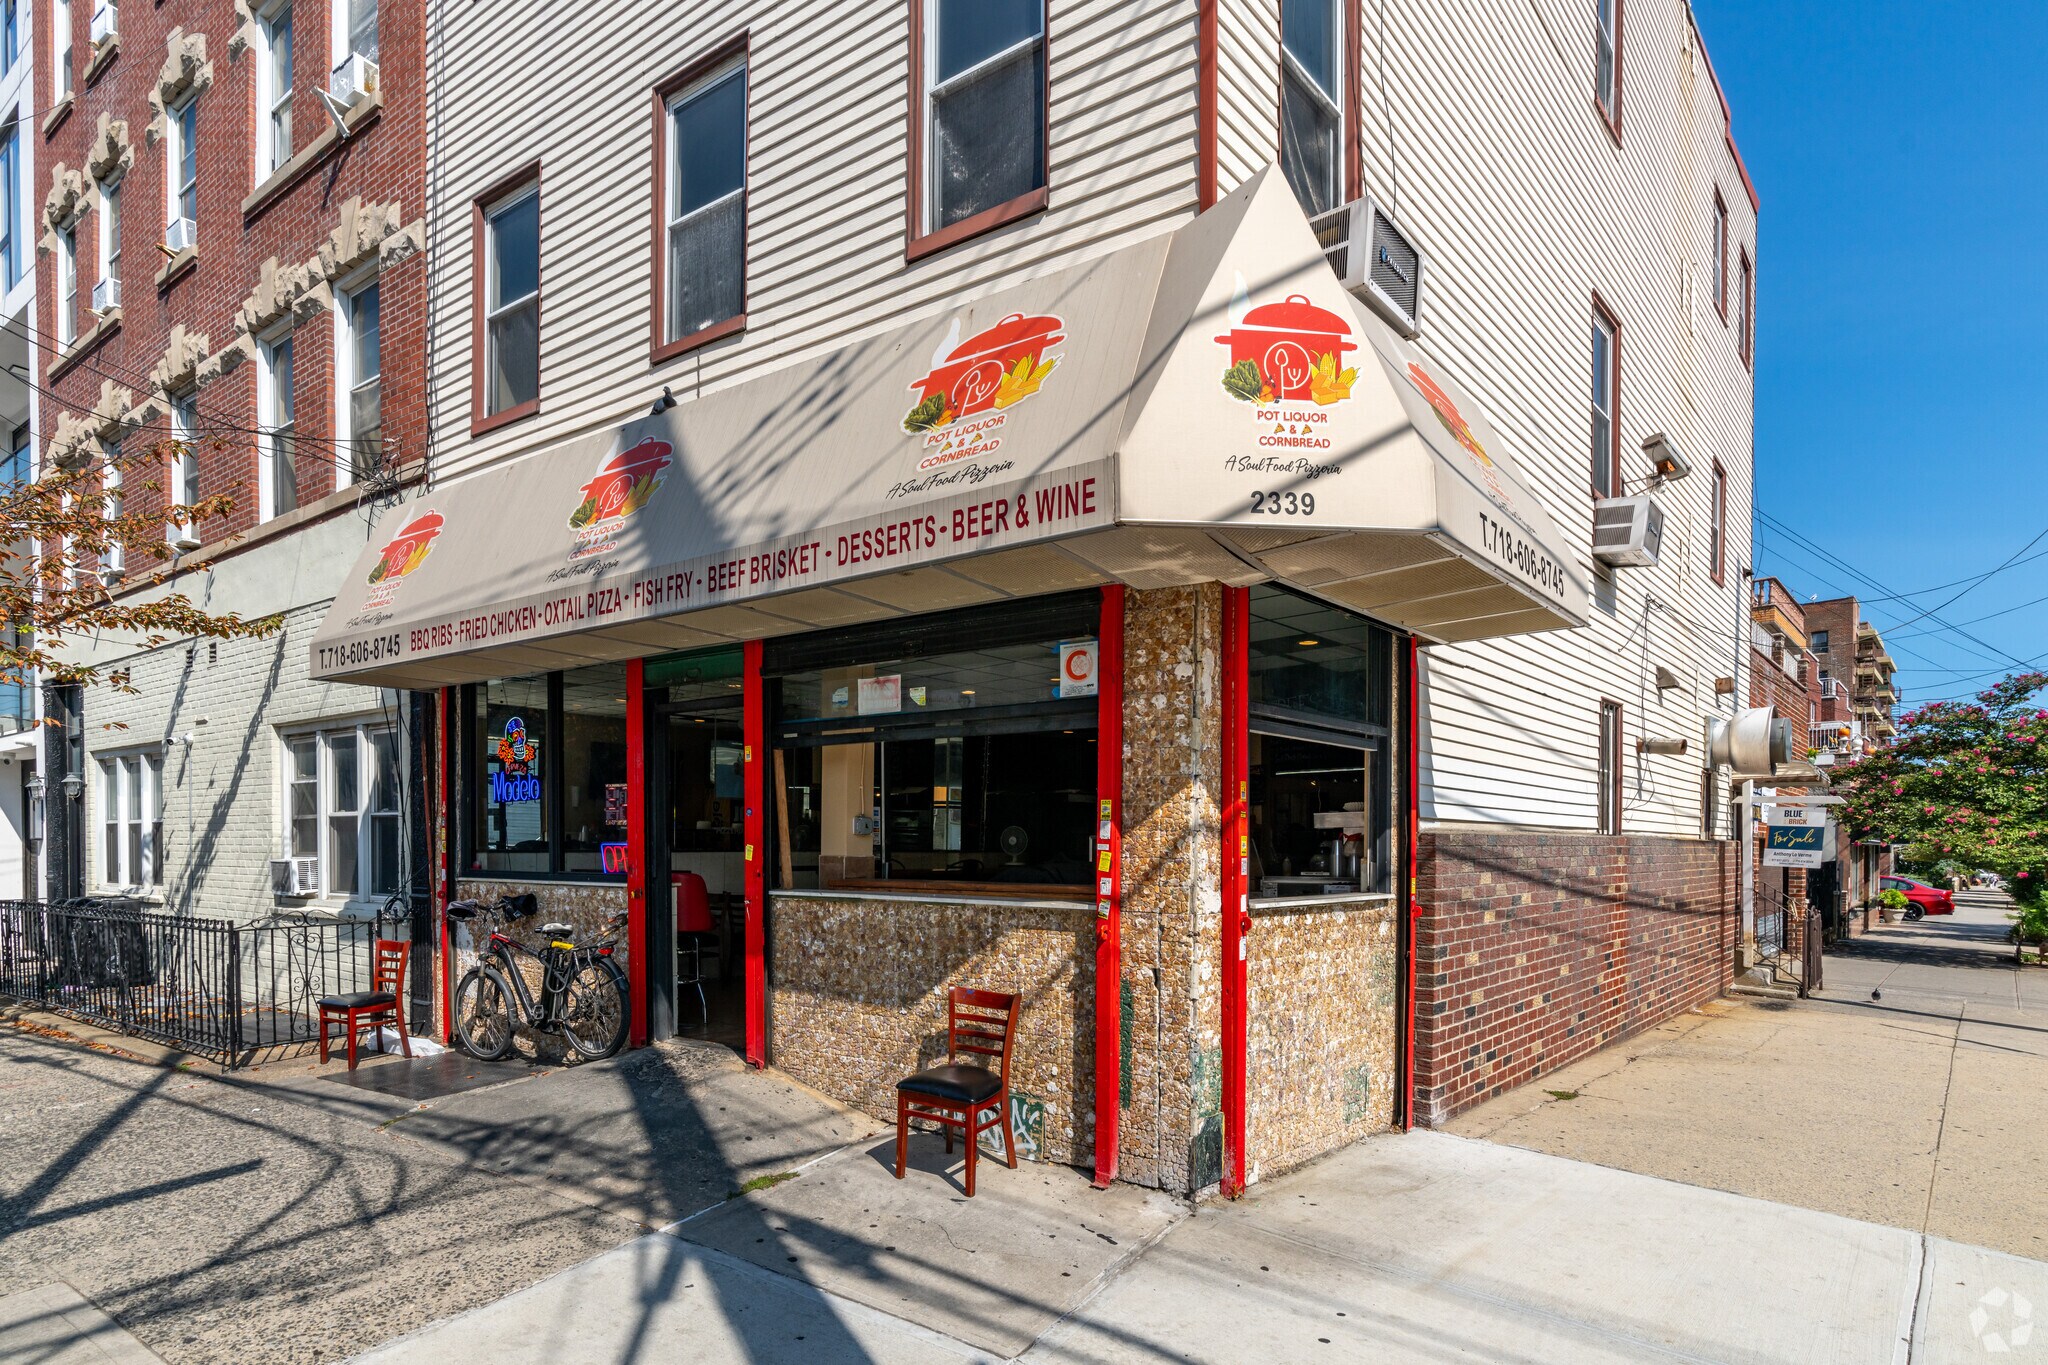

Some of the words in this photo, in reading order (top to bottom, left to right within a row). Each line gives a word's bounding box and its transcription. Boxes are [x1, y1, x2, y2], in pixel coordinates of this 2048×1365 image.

[1257, 410, 1280, 421] POT
[1283, 411, 1328, 423] LIQUOR
[1289, 425, 1297, 434] &
[927, 429, 951, 446] POT
[954, 415, 1006, 437] LIQUOR
[956, 438, 965, 448] &
[1258, 436, 1331, 448] CORNBREAD
[920, 439, 1000, 470] CORNBREAD
[1225, 455, 1237, 471] A
[1238, 456, 1265, 472] Soul
[1265, 457, 1294, 472] Food
[1296, 458, 1342, 479] Pizzeria
[886, 483, 901, 499] A
[899, 479, 931, 497] Soul
[928, 471, 959, 490] Food
[959, 460, 1015, 485] Pizzeria
[1250, 490, 1315, 516] 2339
[578, 529, 592, 540] POT
[594, 522, 624, 536] LIQUOR
[569, 541, 617, 560] CORNBREAD
[1479, 511, 1564, 598] T.718-606-8745
[411, 628, 430, 651] BBQ
[431, 623, 453, 648] RIBS
[459, 616, 488, 643] FRIED
[490, 605, 537, 638] CHICKEN
[544, 596, 585, 626] OXTAIL
[587, 587, 622, 617] PIZZA
[634, 577, 663, 608] FISH
[666, 570, 694, 602] FRY
[708, 558, 746, 593] BEEF
[750, 542, 820, 584] BRISKET
[838, 515, 936, 567] DESSERTS
[952, 498, 1010, 542] BEER
[1015, 493, 1030, 528] &
[1035, 477, 1096, 525] WINE
[319, 634, 401, 670] T.718-606-8745
[1065, 649, 1088, 681] C
[493, 771, 540, 802] Modelo
[1784, 809, 1803, 818] BLUE
[1773, 830, 1789, 846] For
[1787, 828, 1816, 848] Sale
[603, 845, 628, 873] OPE
